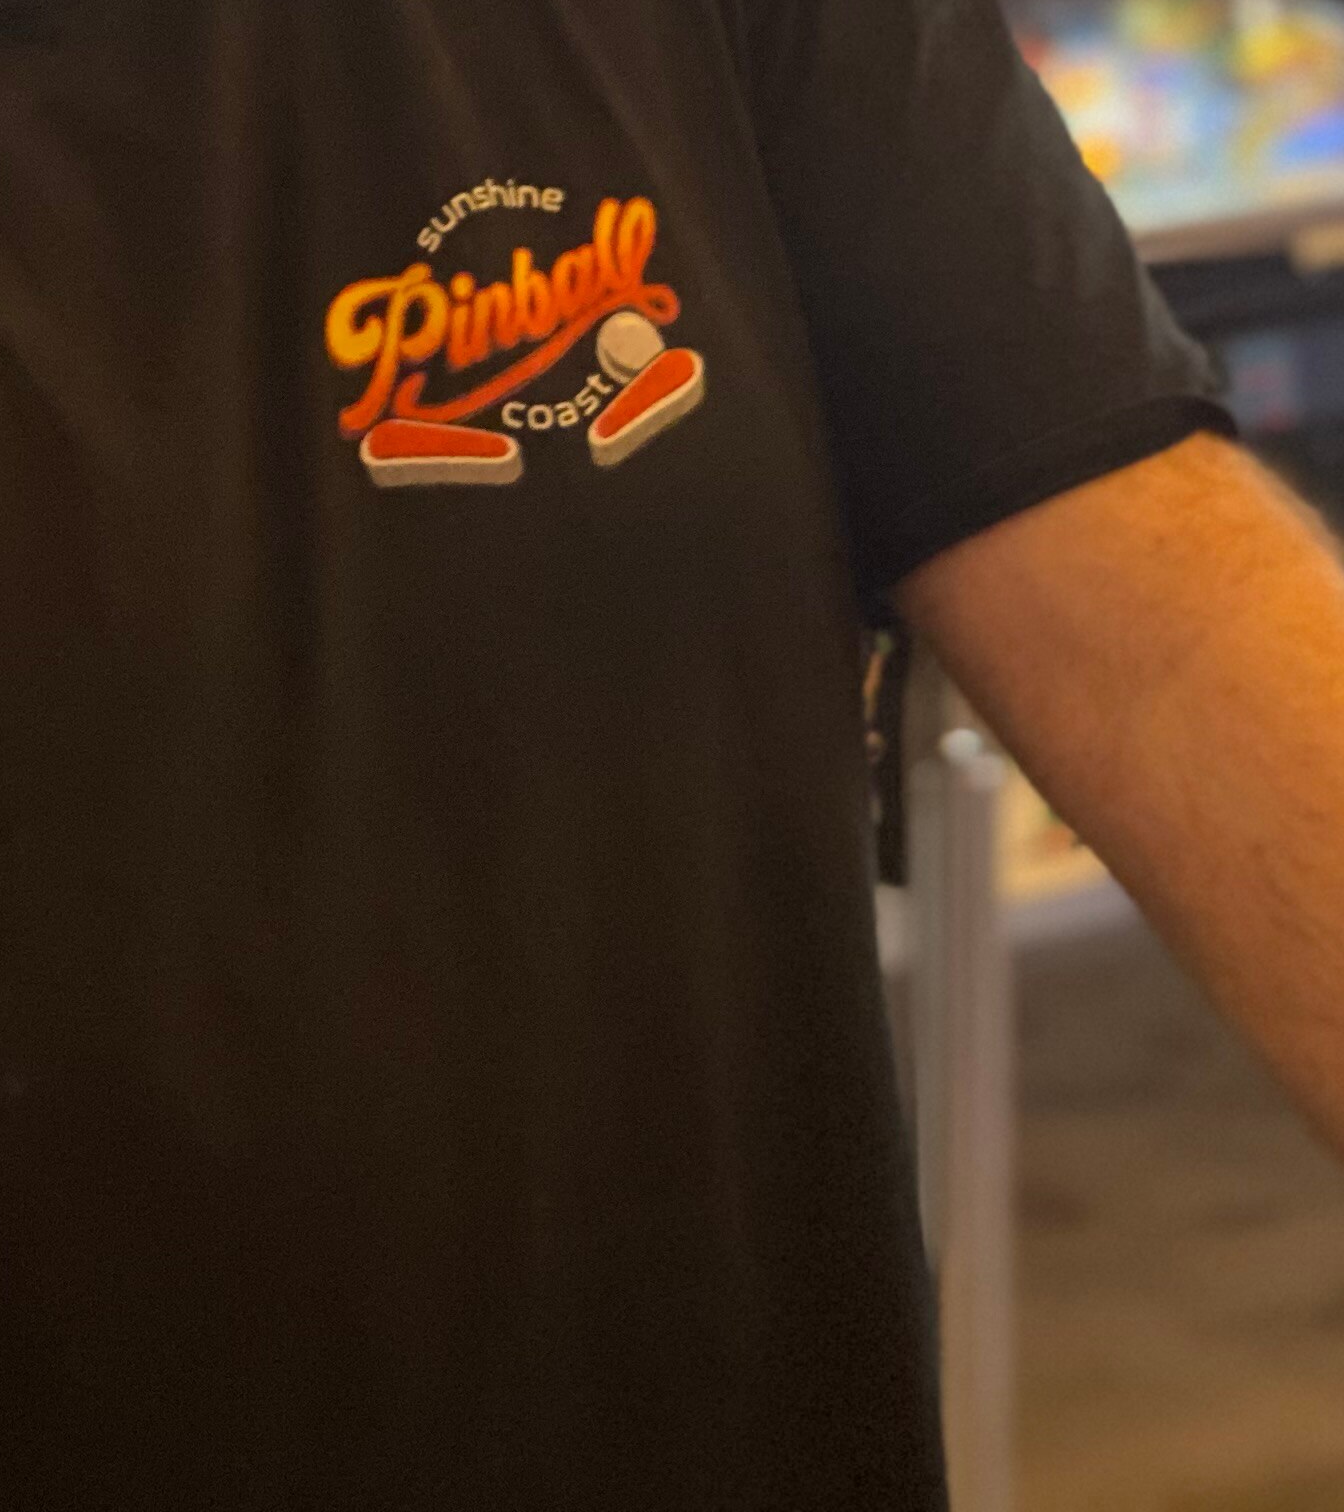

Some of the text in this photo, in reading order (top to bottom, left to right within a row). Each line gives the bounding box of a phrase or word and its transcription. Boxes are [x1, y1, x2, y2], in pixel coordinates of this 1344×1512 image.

[417, 178, 564, 253] sunshine
[324, 196, 681, 439] Pinball
[501, 372, 613, 430] coast
